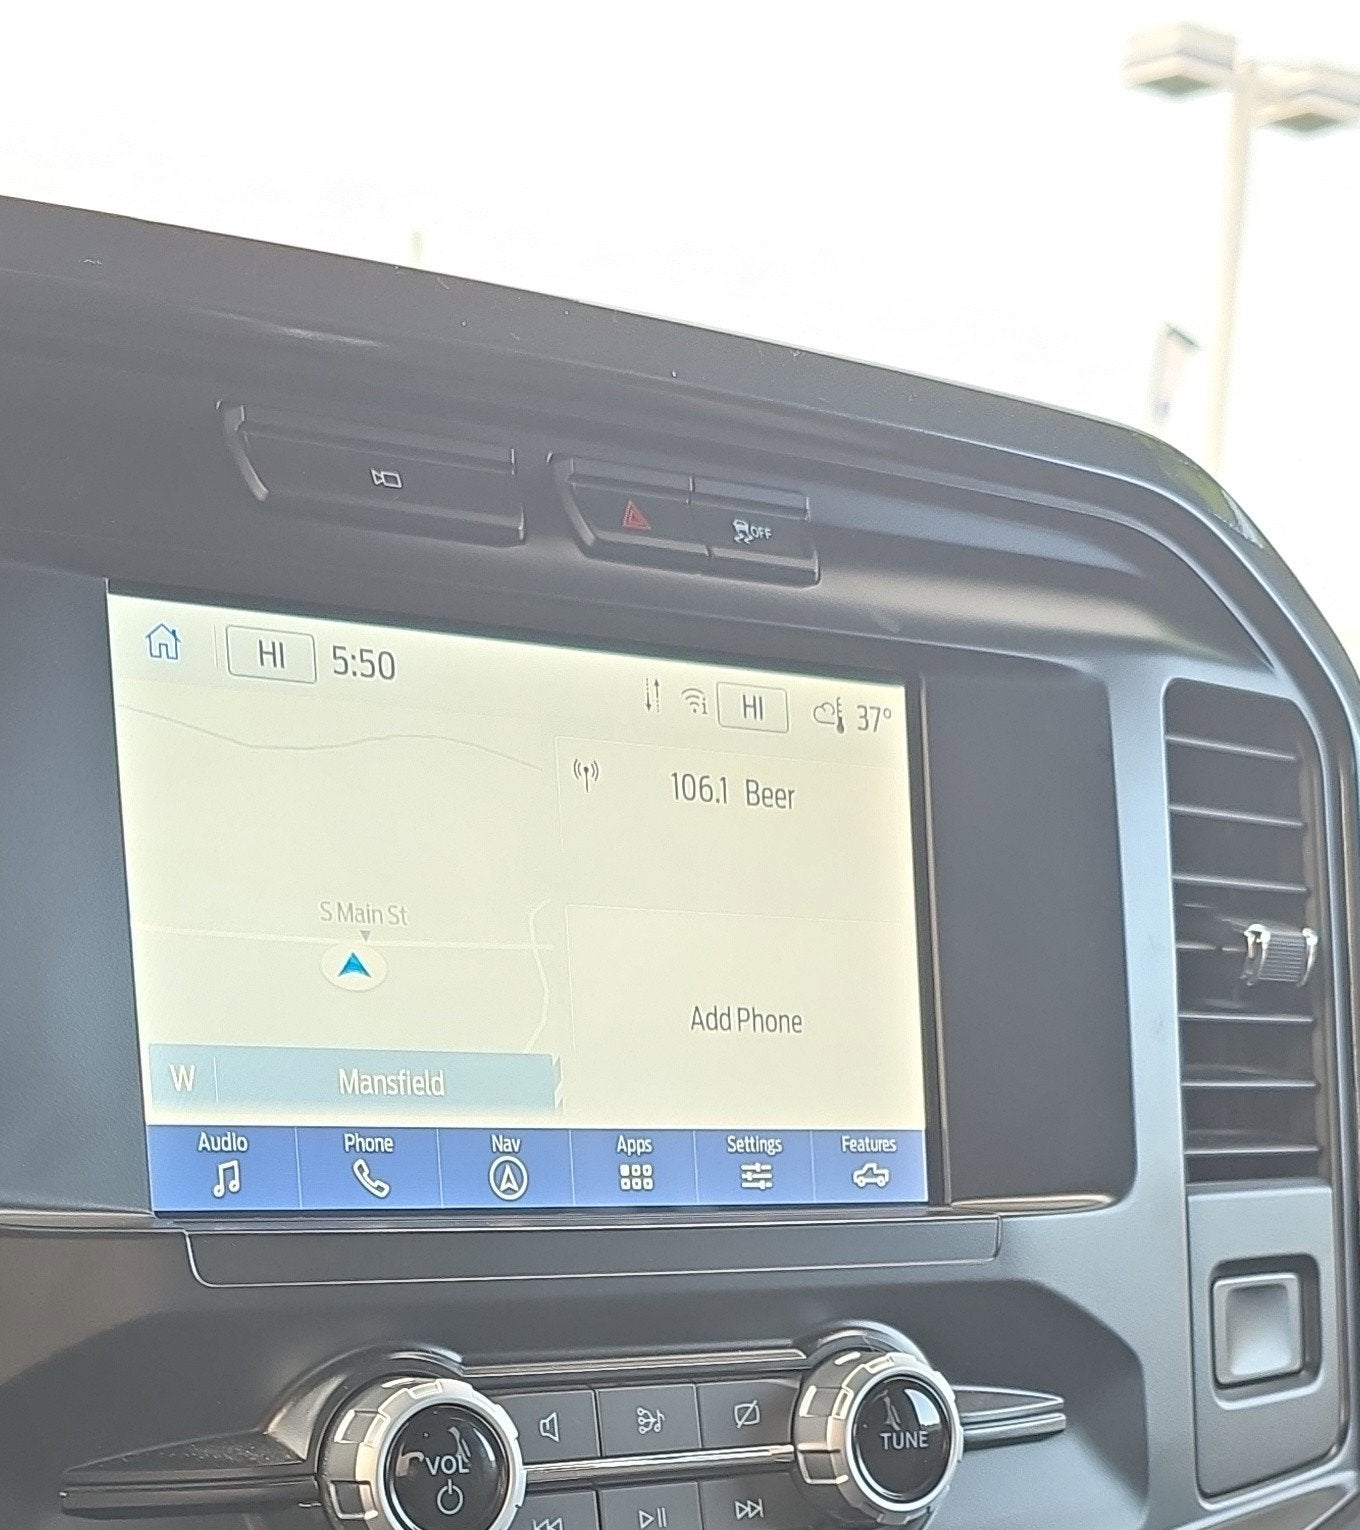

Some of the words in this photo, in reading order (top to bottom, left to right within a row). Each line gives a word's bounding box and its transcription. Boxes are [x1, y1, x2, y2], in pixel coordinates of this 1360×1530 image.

[750, 525, 772, 540] OFF
[258, 639, 285, 669] HI
[331, 645, 395, 680] 5:50
[742, 694, 763, 721] HI
[856, 704, 892, 732] 37°
[671, 772, 728, 804] 106.1
[745, 779, 795, 810] Beer
[320, 901, 333, 922] S
[337, 902, 384, 925] Main
[387, 905, 408, 926] St
[690, 1005, 732, 1032] Add
[737, 1006, 803, 1034] Phone
[169, 1064, 195, 1092] W
[338, 1068, 446, 1097] Mansfield
[197, 1131, 249, 1153] Audio
[343, 1133, 395, 1153] Phone
[491, 1135, 521, 1153] Nav
[616, 1135, 653, 1157] Apps
[726, 1135, 783, 1157] Settings
[841, 1135, 897, 1153] Features
[879, 1429, 930, 1452] TUNE
[425, 1452, 471, 1477] VOL
